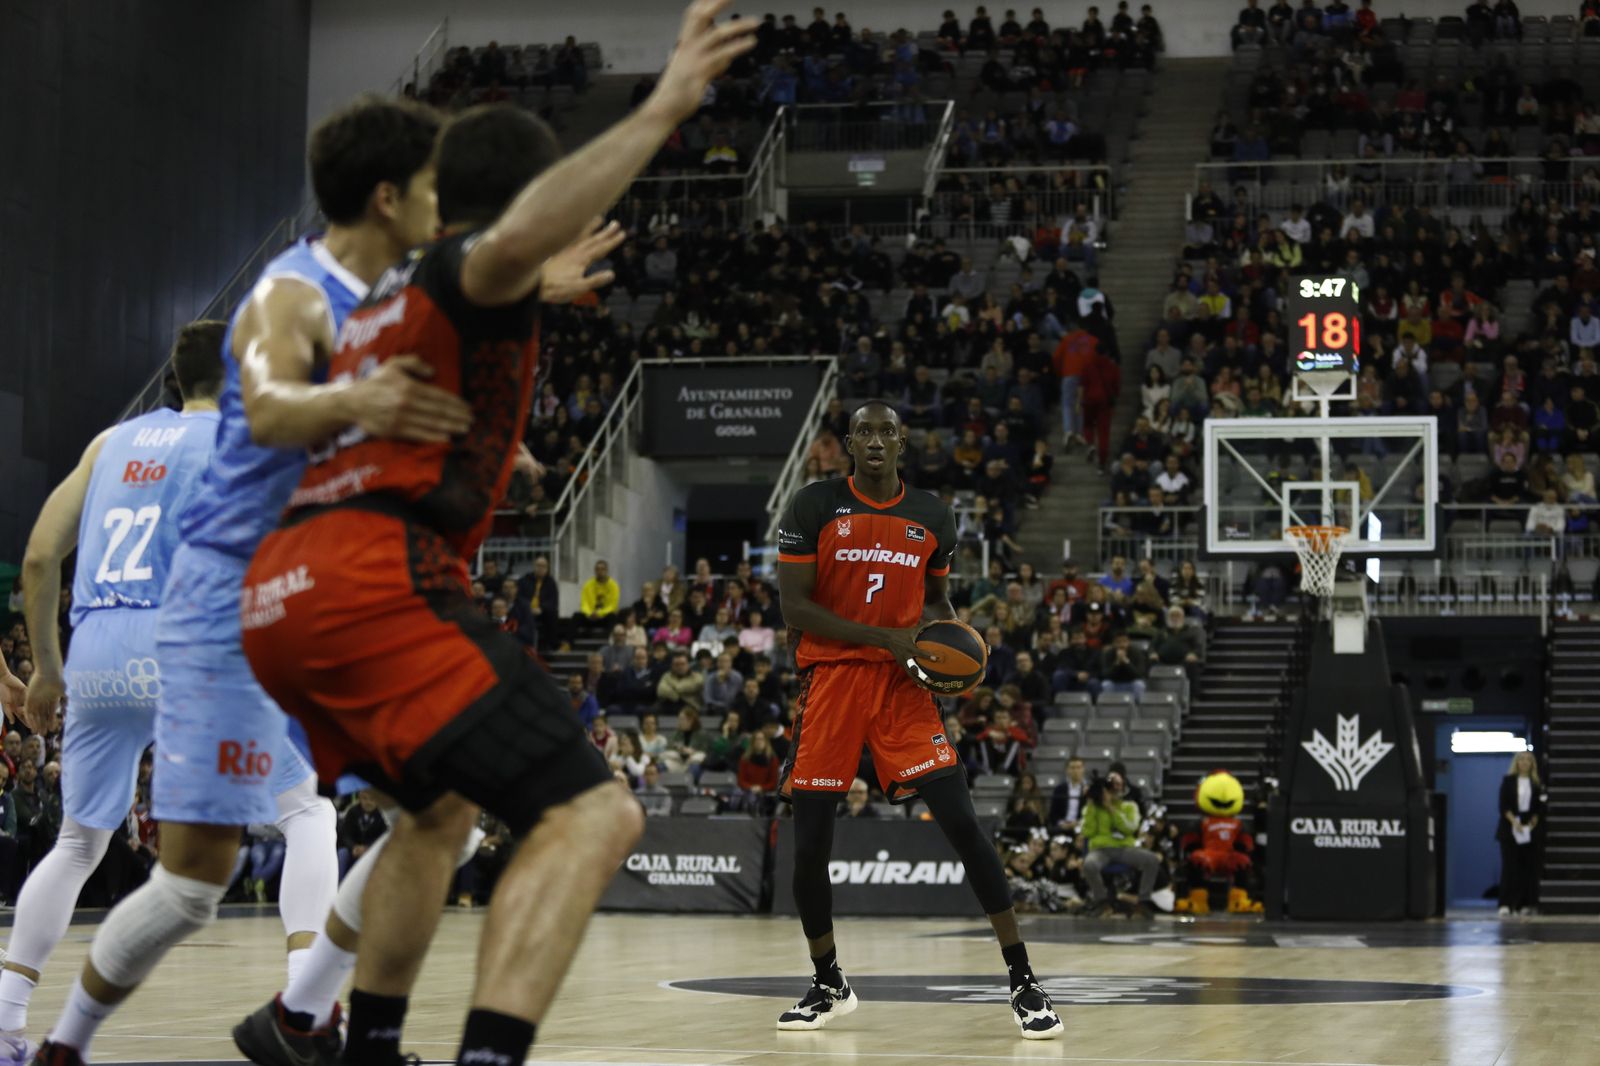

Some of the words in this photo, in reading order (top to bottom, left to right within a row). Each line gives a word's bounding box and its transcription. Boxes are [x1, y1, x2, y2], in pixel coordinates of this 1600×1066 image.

[1300, 278, 1346, 298] 3:47
[1298, 311, 1349, 349] 18
[95, 504, 162, 584] 22
[865, 573, 884, 604] 7
[1290, 817, 1336, 835] CAJA
[1340, 818, 1406, 837] RURAL
[1313, 836, 1381, 849] GRANADA
[626, 853, 672, 872] CAJA
[675, 854, 741, 873] RURAL
[828, 850, 966, 884] OVIRAN
[647, 872, 715, 886] GRANADA
